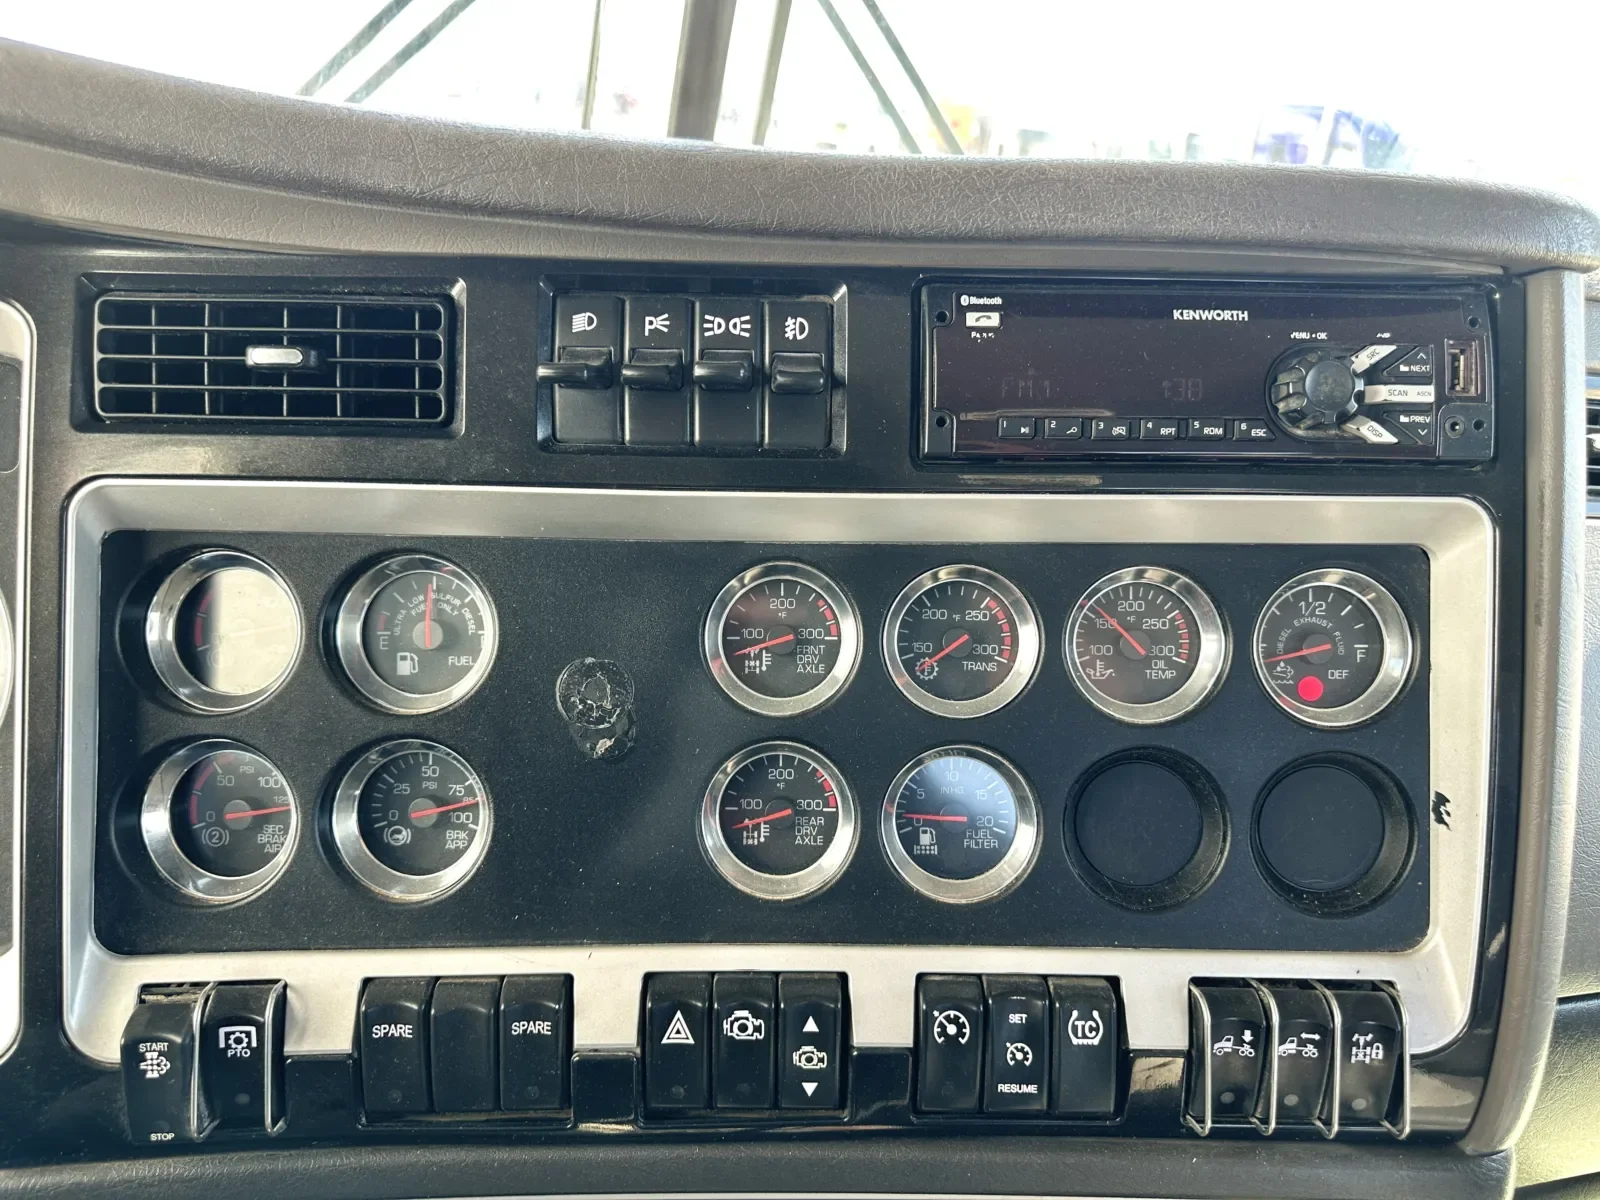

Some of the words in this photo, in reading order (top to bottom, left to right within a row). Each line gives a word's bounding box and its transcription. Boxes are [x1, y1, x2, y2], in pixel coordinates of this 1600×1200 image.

[970, 296, 1002, 305] Bluetooth
[1173, 309, 1248, 322] KENWORTH
[1316, 332, 1327, 340] OK
[1366, 348, 1380, 361] SRC
[1410, 364, 1430, 372] NEXT
[1387, 388, 1408, 397] SCAN
[1410, 415, 1430, 423] PREV
[1193, 421, 1199, 429] 5
[1160, 427, 1176, 436] RPT
[1203, 427, 1223, 435] RDM
[1251, 429, 1267, 437] ESC
[1367, 425, 1383, 439] DISP
[437, 602, 459, 616] ONLY
[769, 598, 796, 609] 200
[1118, 601, 1145, 611] 200
[1298, 601, 1326, 616] 1/2
[393, 609, 407, 636] ULTRA
[408, 594, 425, 607] LOW
[431, 592, 462, 607] SULFUR
[461, 607, 476, 636] DIESEL
[922, 609, 947, 620] 200
[965, 610, 989, 621] 250
[1094, 618, 1117, 629] 150
[1142, 619, 1169, 629] 250
[741, 628, 764, 639] 100
[798, 628, 824, 639] 300
[1276, 627, 1292, 655] DIESEL
[1293, 616, 1333, 630] EXHAUST
[1333, 631, 1345, 656] FLUID
[380, 636, 389, 650] E
[912, 642, 932, 653] 150
[797, 645, 825, 654] FRNT
[972, 644, 998, 655] 300
[1089, 645, 1113, 655] 100
[1148, 645, 1175, 656] 300
[448, 655, 475, 666] FUEL
[797, 654, 820, 664] DRV
[1357, 650, 1366, 663] F
[797, 664, 825, 673] AXLE
[962, 661, 997, 672] TRANS
[1152, 659, 1168, 669] OIL
[1145, 670, 1176, 680] TEMP
[1328, 669, 1348, 680] DEF
[240, 766, 254, 774] PSI
[421, 765, 439, 777] 50
[768, 768, 794, 780] 200
[217, 774, 235, 787] 50
[944, 770, 959, 782] 10
[257, 776, 281, 788] 100
[422, 781, 437, 790] PSI
[393, 783, 410, 794] 25
[448, 784, 465, 796] 75
[916, 788, 925, 799] 5
[273, 795, 290, 803] 125
[975, 789, 988, 800] 15
[740, 798, 763, 810] 100
[796, 799, 823, 811] 300
[206, 811, 216, 822] 0
[388, 809, 399, 821] 0
[448, 811, 473, 823] 100
[795, 816, 825, 826] REAR
[976, 815, 994, 827] 20
[263, 824, 284, 835] SEC
[446, 829, 469, 840] BRK
[795, 826, 818, 836] DRV
[966, 829, 993, 839] FUEL
[445, 840, 468, 849] APP
[795, 836, 824, 845] AXLE
[963, 839, 999, 849] FILTER
[264, 843, 282, 853] AIR
[1008, 1013, 1028, 1024] SET
[372, 1024, 413, 1038] SPARE
[511, 1020, 552, 1035] SPARE
[139, 1042, 169, 1052] START
[227, 1048, 251, 1057] PTO
[997, 1084, 1038, 1094] RESUME
[151, 1132, 175, 1141] STOP
